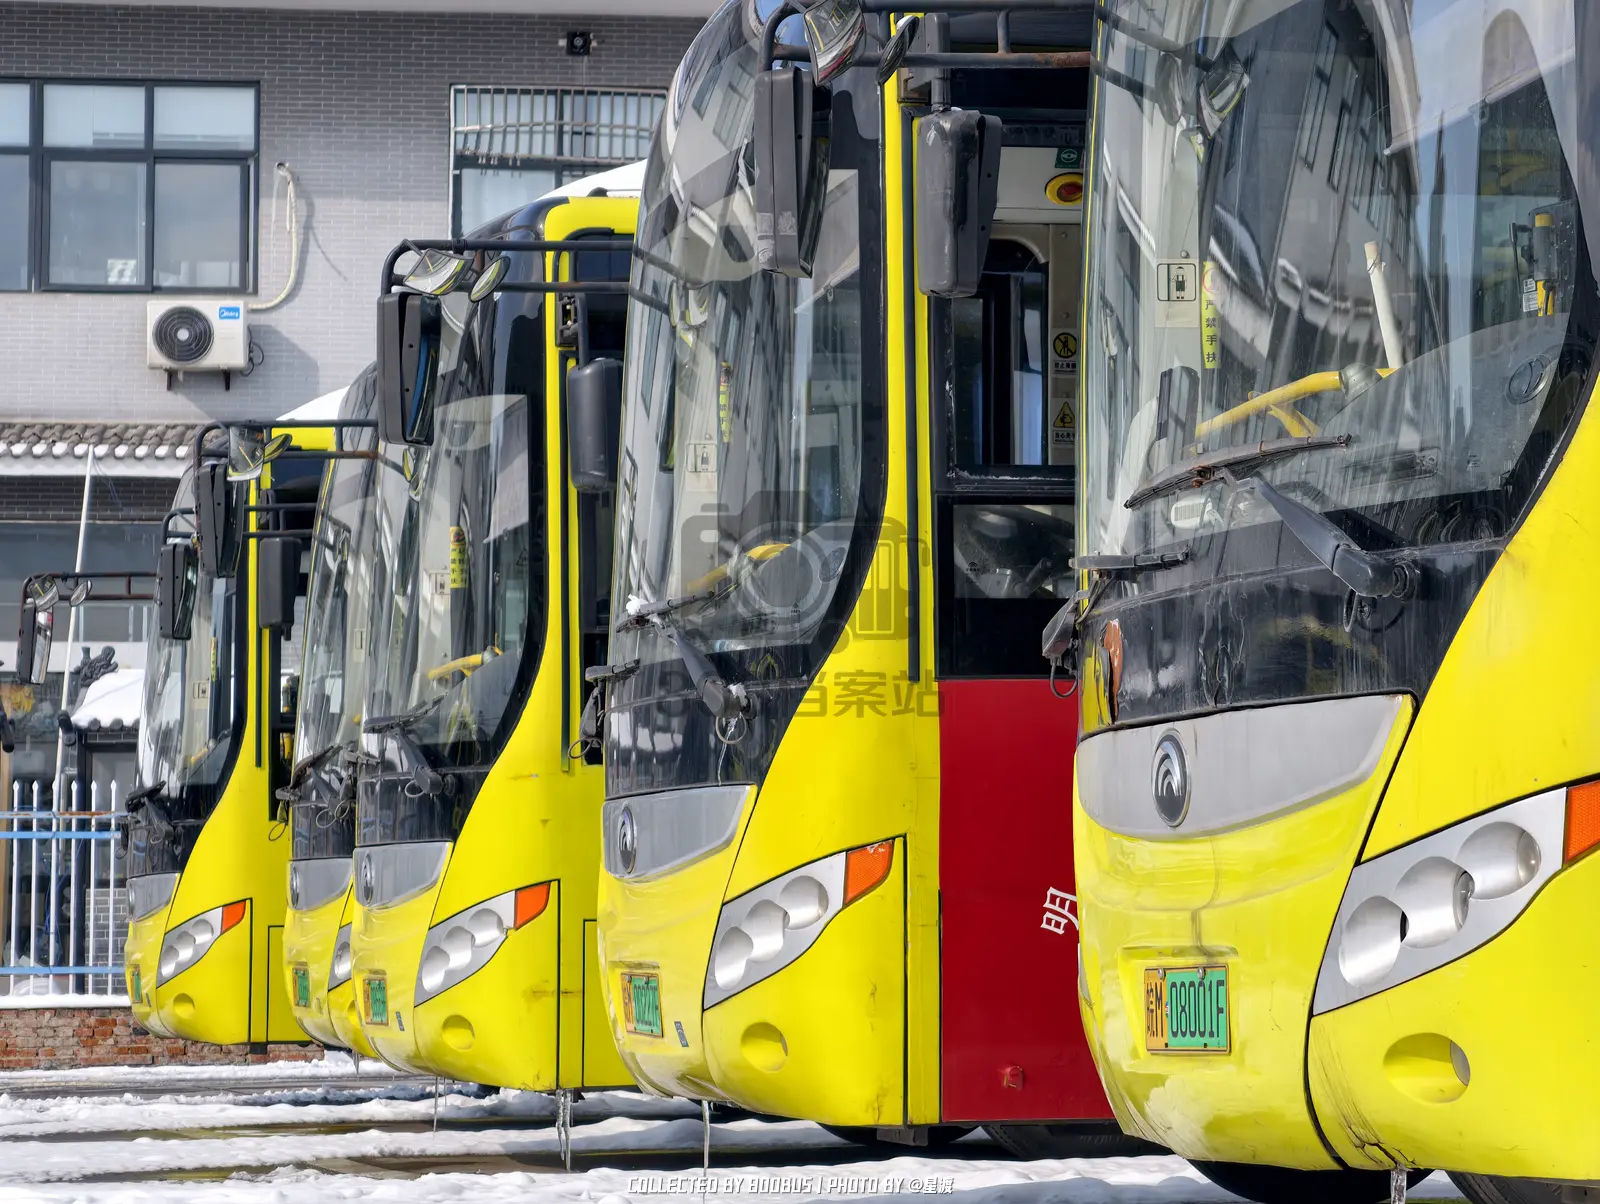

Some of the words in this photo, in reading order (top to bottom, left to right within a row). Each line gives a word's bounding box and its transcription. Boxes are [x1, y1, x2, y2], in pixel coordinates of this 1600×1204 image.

[1205, 300, 1217, 362] 严禁手扶
[1040, 886, 1079, 934] 明
